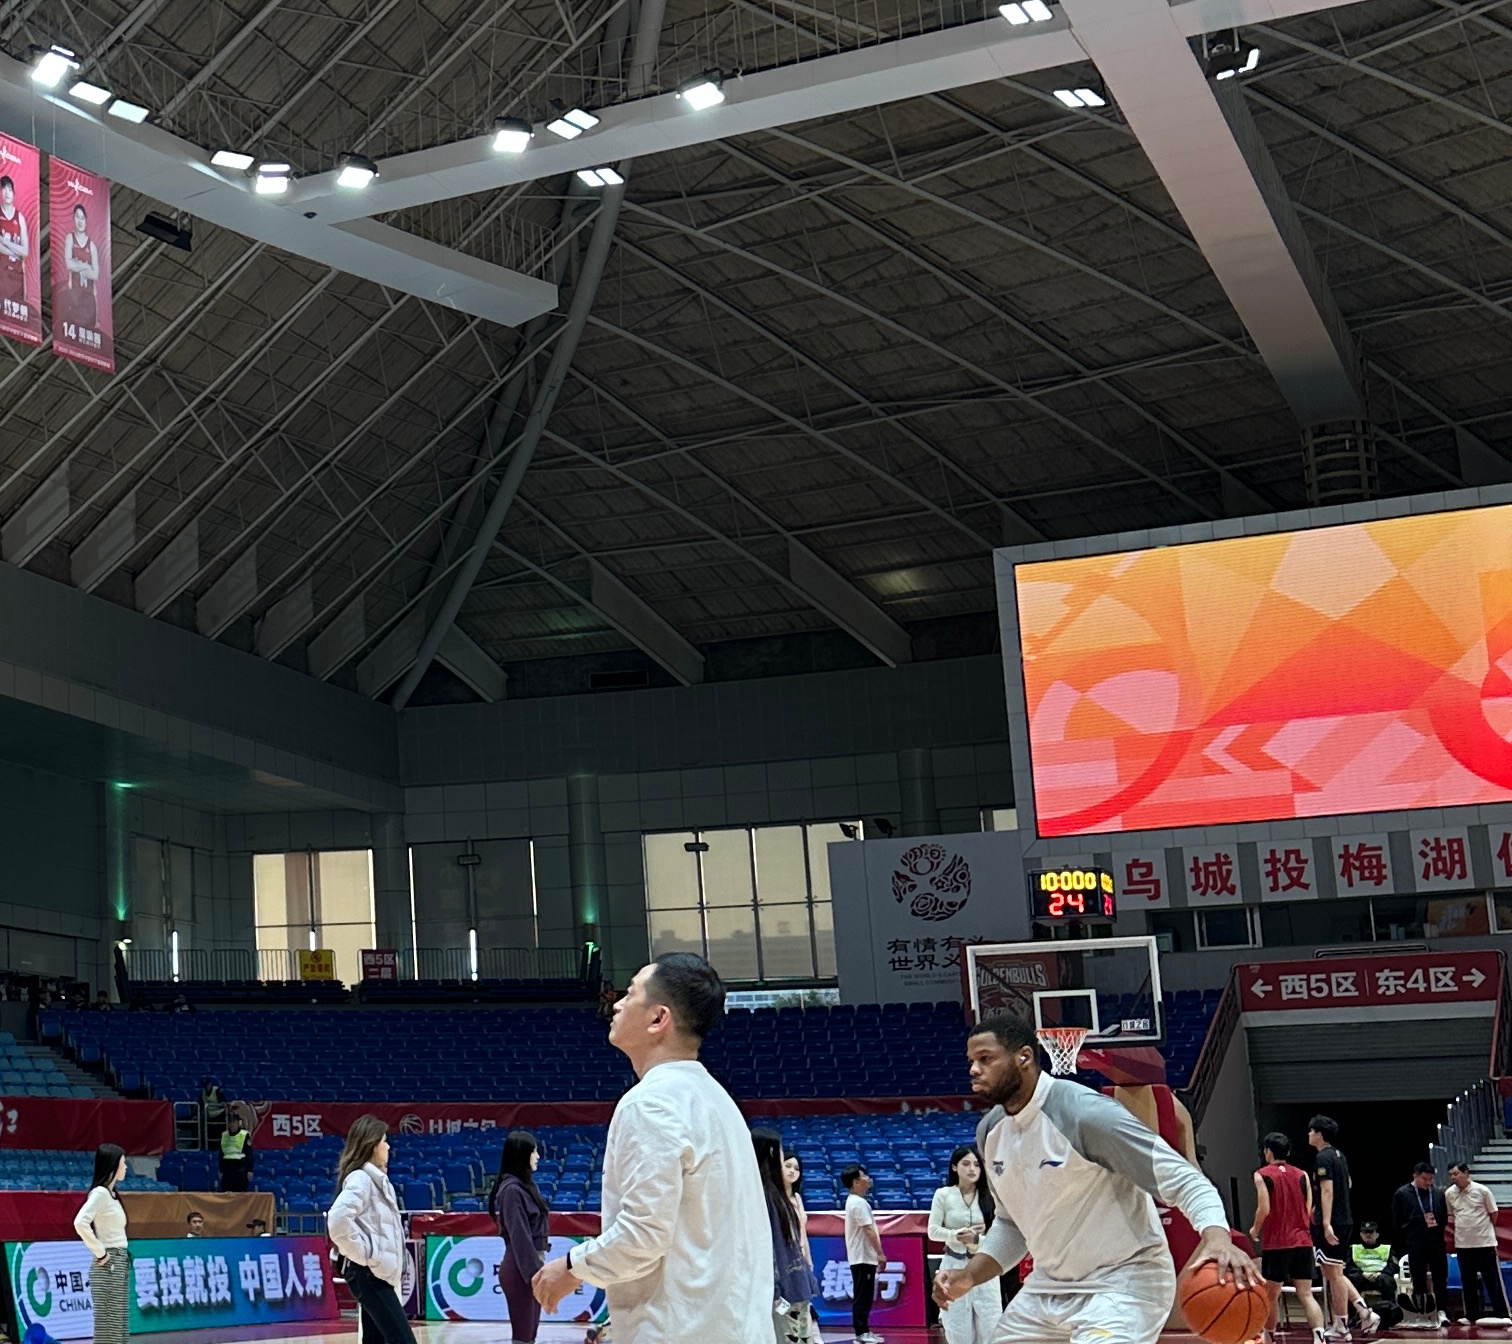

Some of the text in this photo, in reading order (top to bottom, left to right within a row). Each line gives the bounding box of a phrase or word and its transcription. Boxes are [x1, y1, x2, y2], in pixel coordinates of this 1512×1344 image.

[62, 322, 77, 340] 14
[1049, 892, 1085, 916] 24
[364, 953, 395, 965] 西5区
[1278, 966, 1459, 1001] 西5区 东4区
[272, 1114, 324, 1137] 西5区
[54, 1269, 91, 1293] 中国
[133, 1252, 325, 1309] 要投就投 中国人寿
